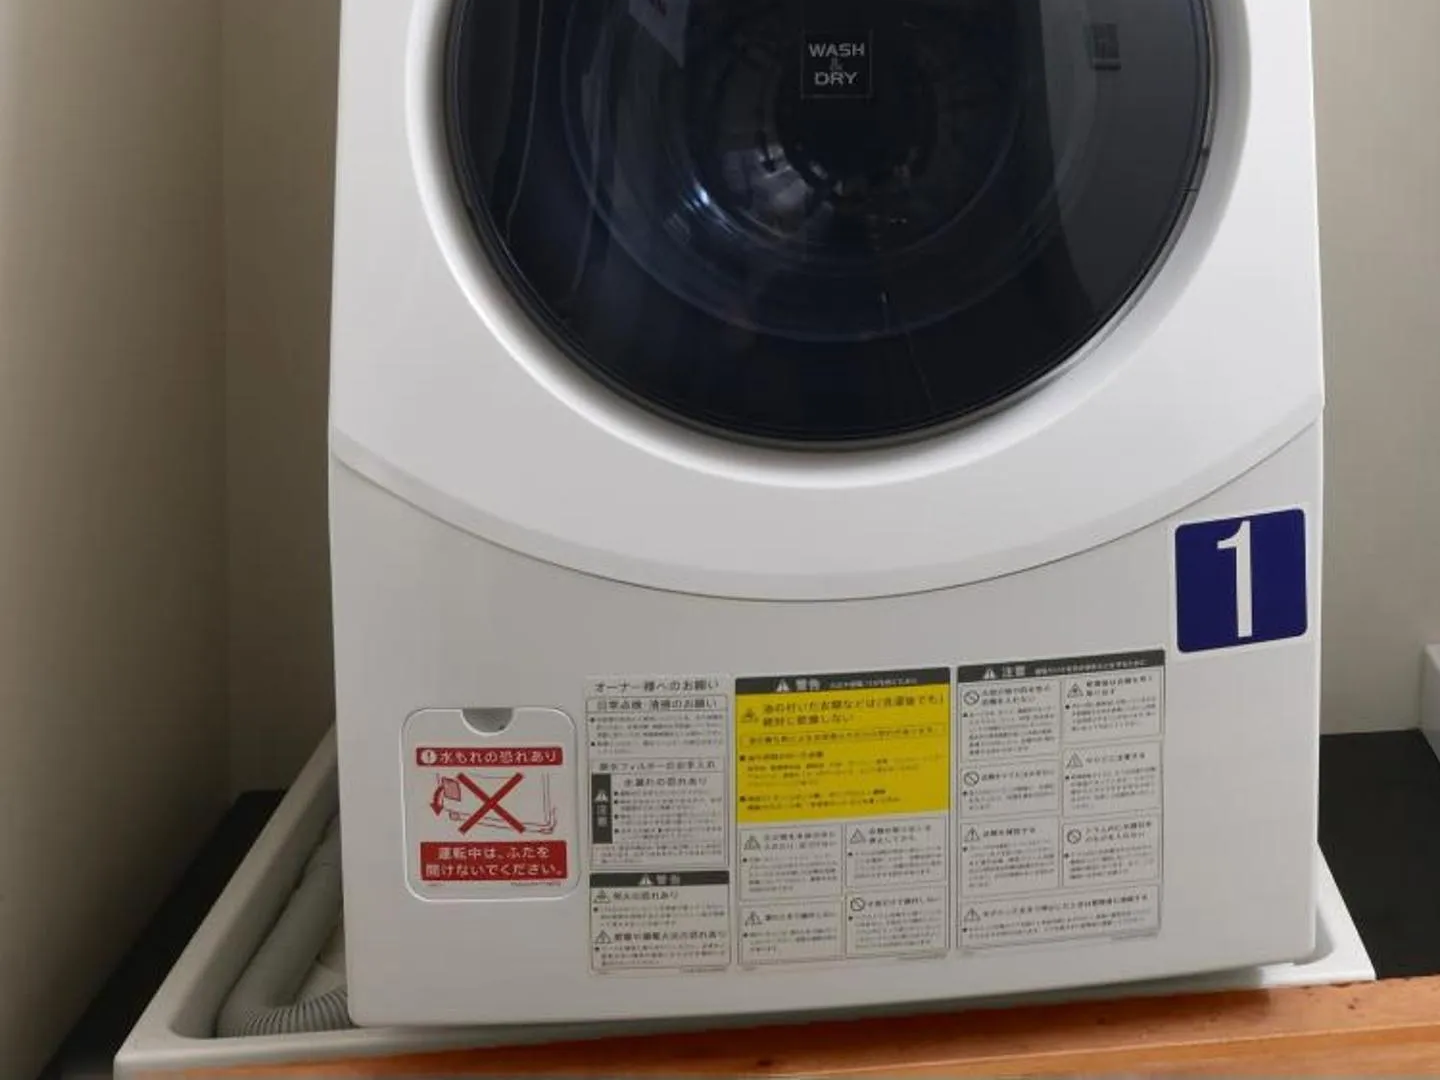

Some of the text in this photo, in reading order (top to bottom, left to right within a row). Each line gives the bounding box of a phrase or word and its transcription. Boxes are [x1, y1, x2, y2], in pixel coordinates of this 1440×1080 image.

[808, 43, 865, 57] WASH
[814, 71, 857, 86] DRY
[1217, 520, 1252, 637] 1
[438, 750, 557, 765] 水もれの恐れあり
[438, 846, 550, 860] 運転中は、ふたを
[425, 862, 564, 879] 開けないでください。
